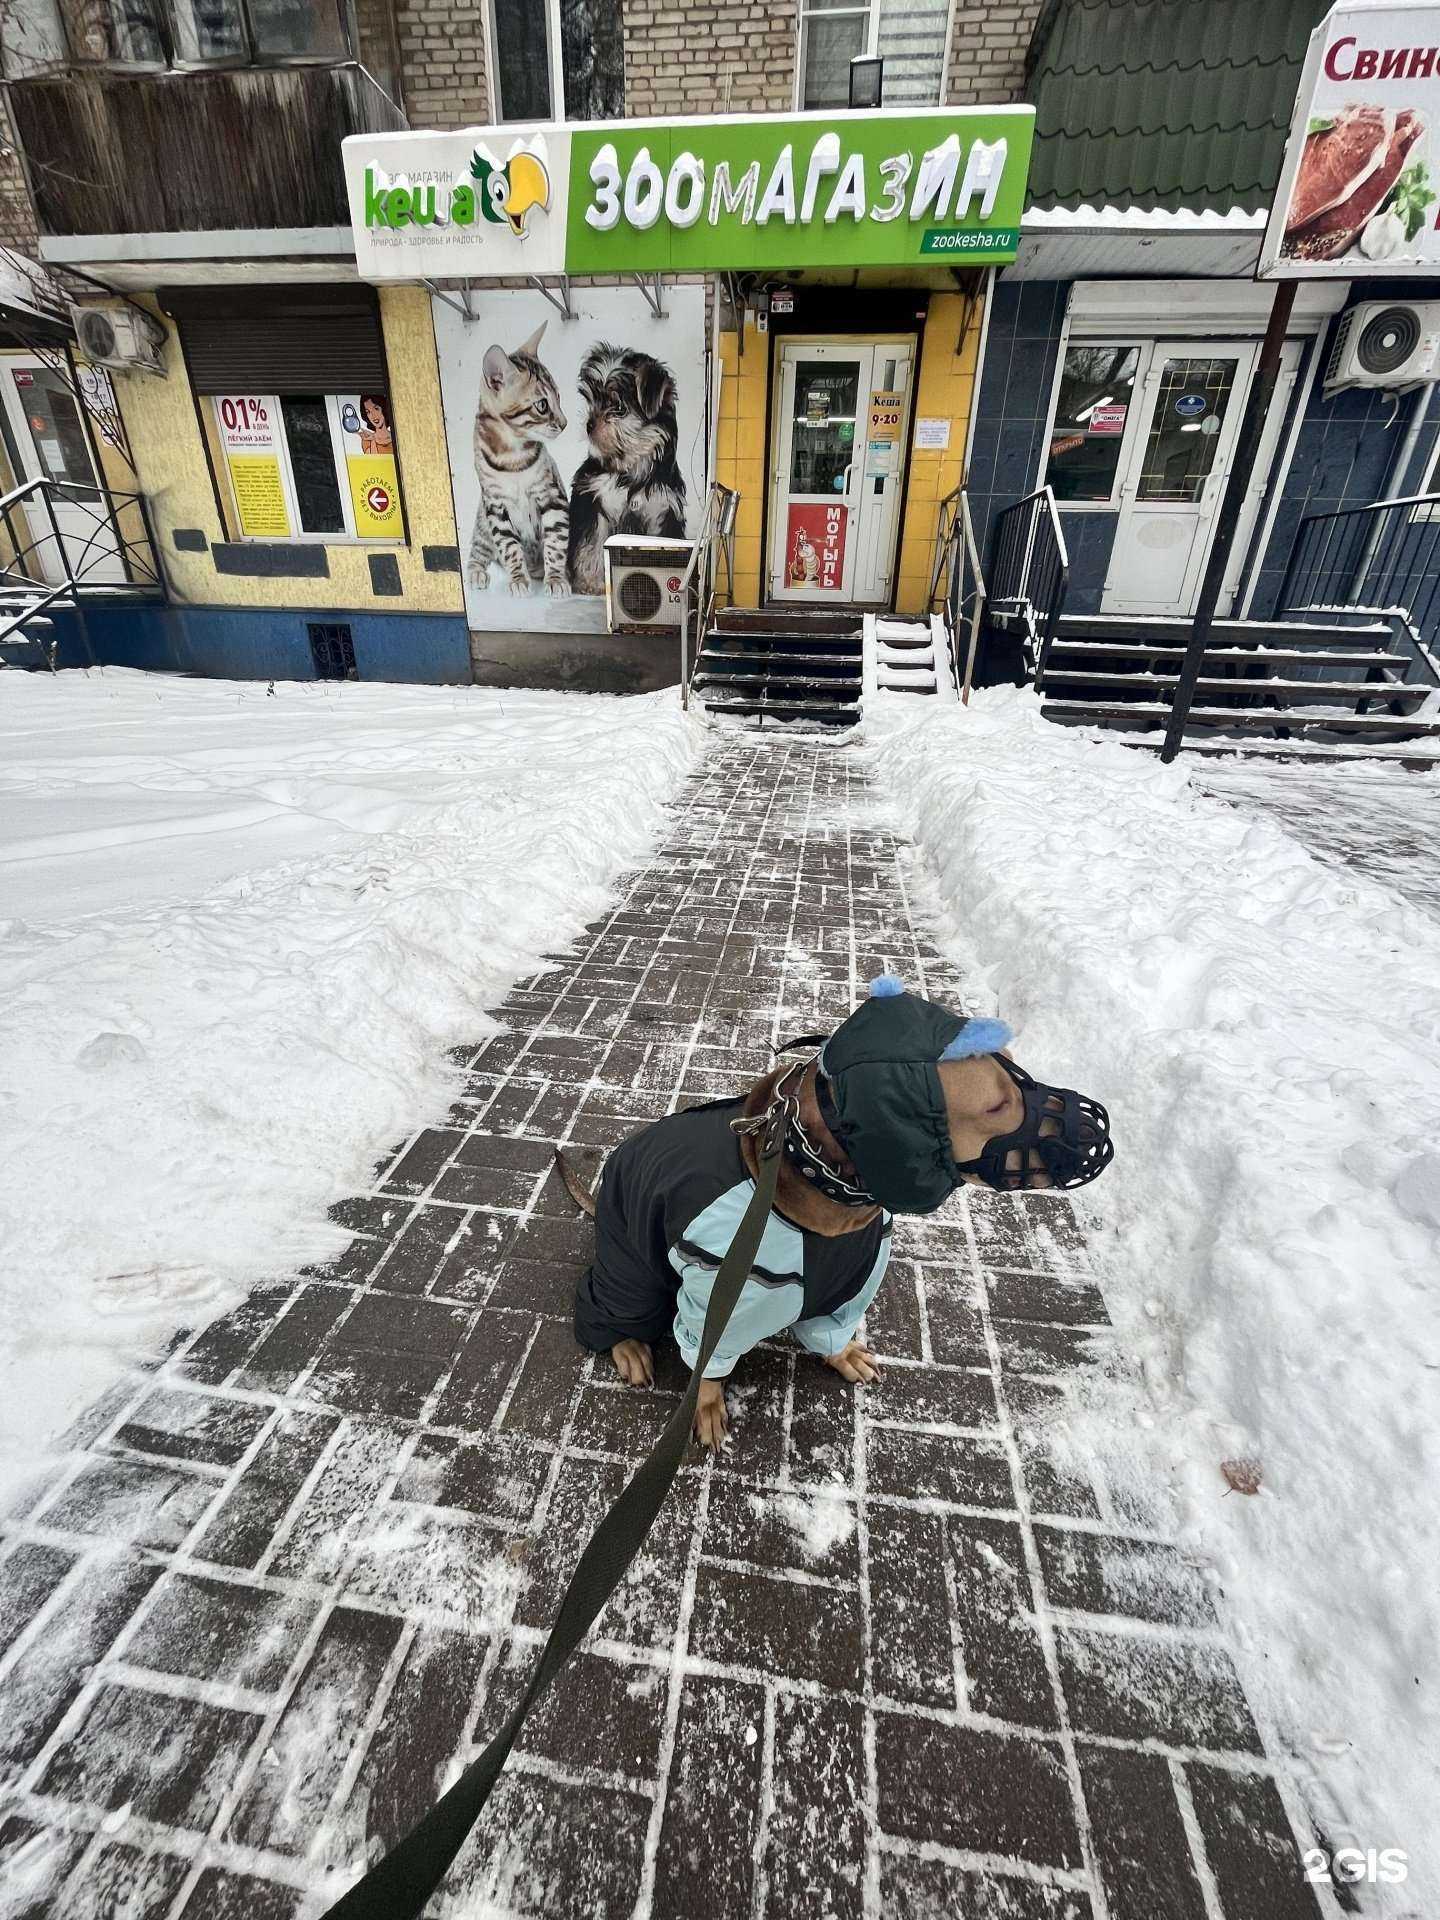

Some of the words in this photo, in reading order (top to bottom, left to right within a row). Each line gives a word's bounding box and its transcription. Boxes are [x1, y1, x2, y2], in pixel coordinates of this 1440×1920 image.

[1324, 37, 1440, 82] Свин
[585, 134, 1007, 231] ЗООМАГАЗИН
[453, 234, 484, 245] РАДОСТЬ
[931, 231, 1011, 248] zookesha.ru
[873, 396, 900, 407] Кеша
[823, 507, 841, 587] МОТЫЛЬ
[668, 595, 681, 603] LG
